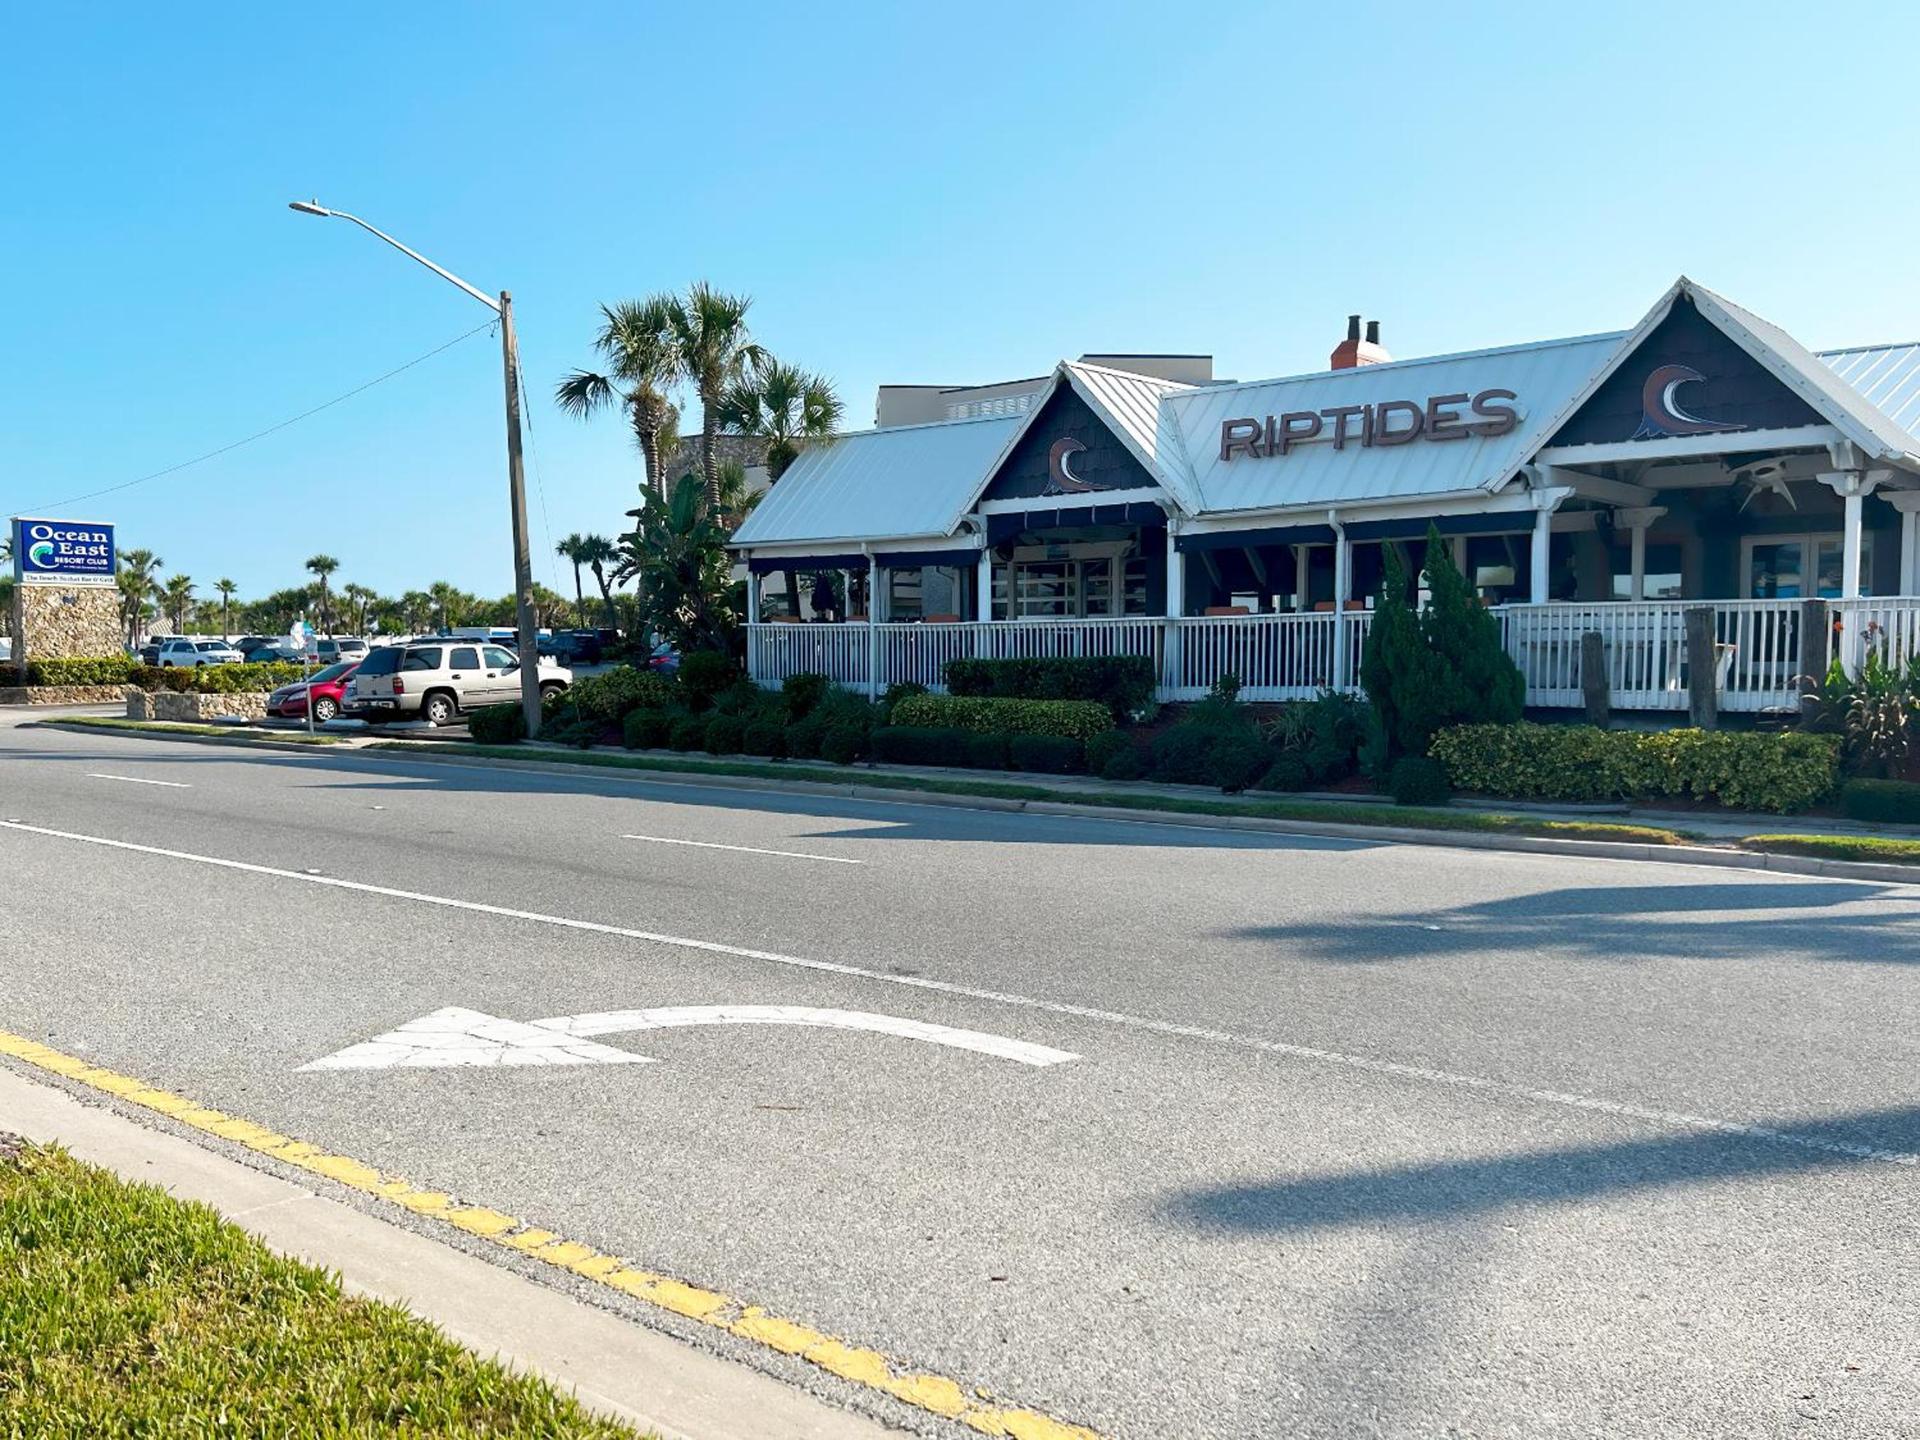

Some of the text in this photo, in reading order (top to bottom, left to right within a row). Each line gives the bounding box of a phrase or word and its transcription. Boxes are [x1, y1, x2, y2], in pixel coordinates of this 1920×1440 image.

[1220, 388, 1518, 461] RIPTIDES
[30, 525, 108, 543] Ocean
[58, 542, 109, 557] East
[54, 556, 108, 566] RESORT CLUB
